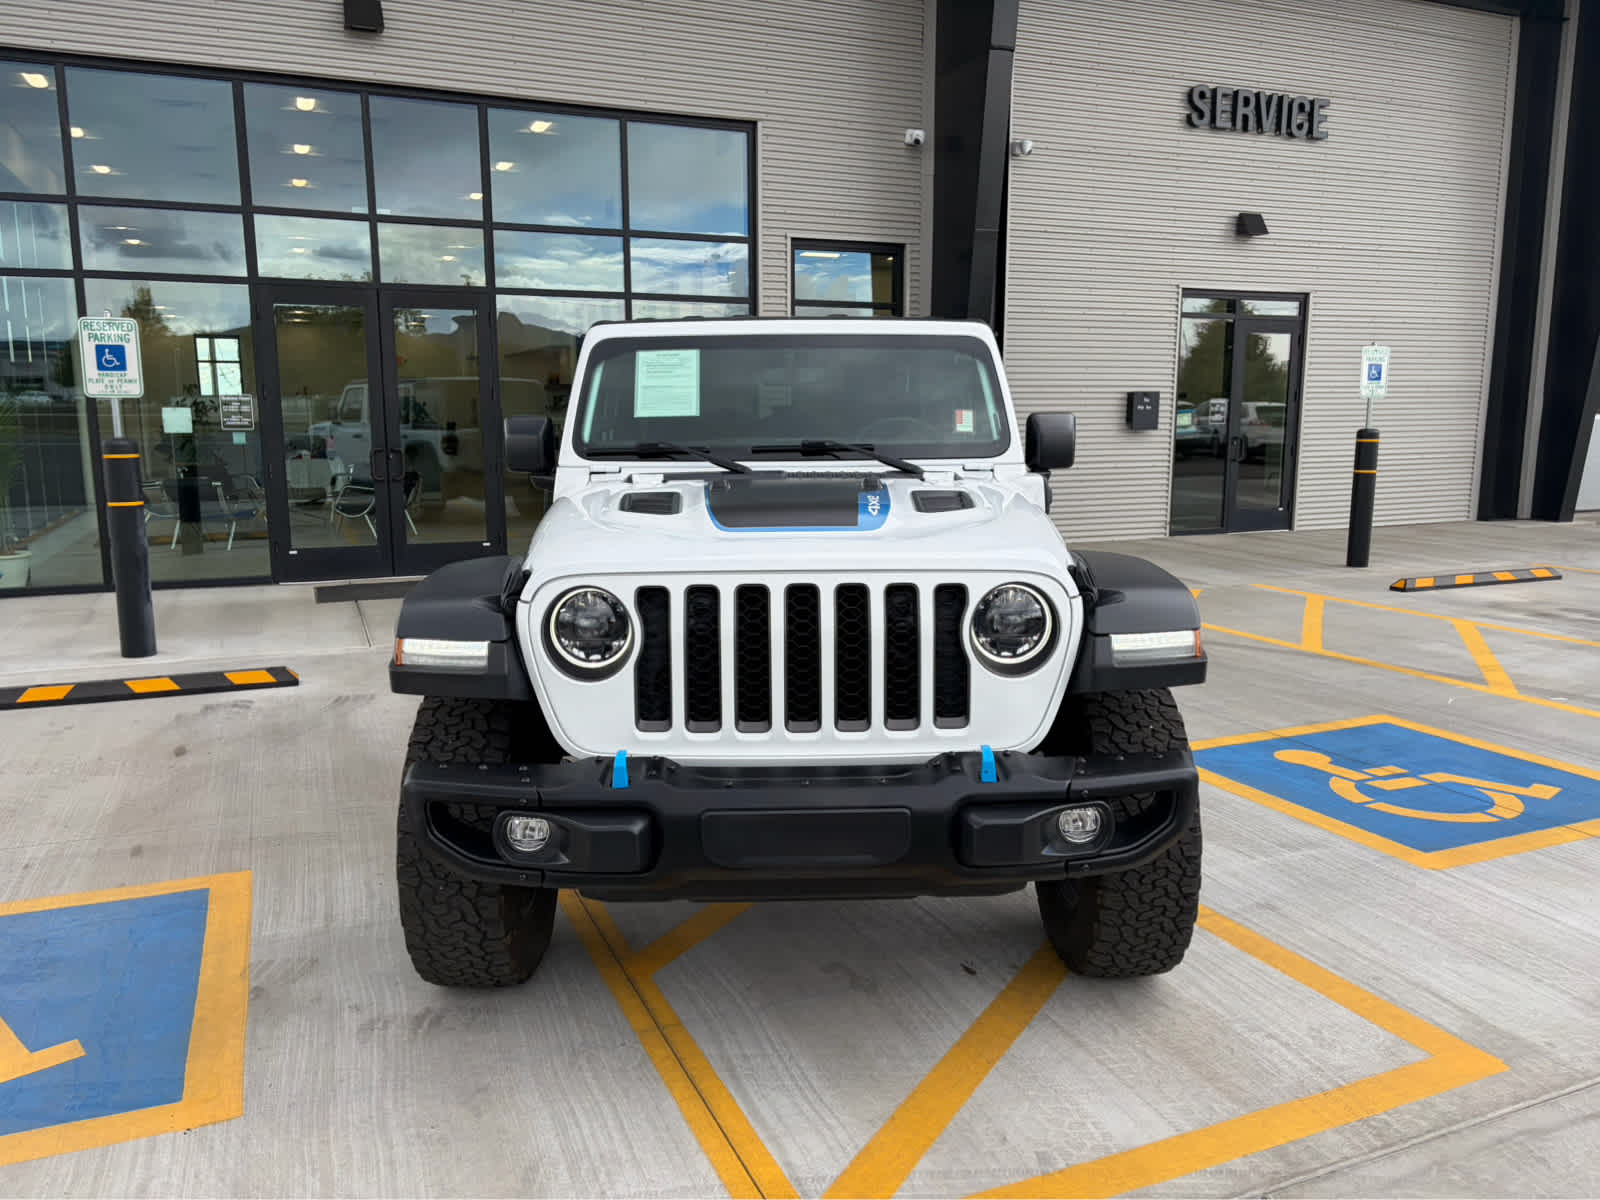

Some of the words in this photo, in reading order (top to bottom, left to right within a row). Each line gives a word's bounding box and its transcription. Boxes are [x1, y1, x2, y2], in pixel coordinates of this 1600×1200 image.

[1186, 84, 1330, 140] SERVICE
[83, 321, 133, 332] RESERVED
[88, 332, 130, 343] PARKING
